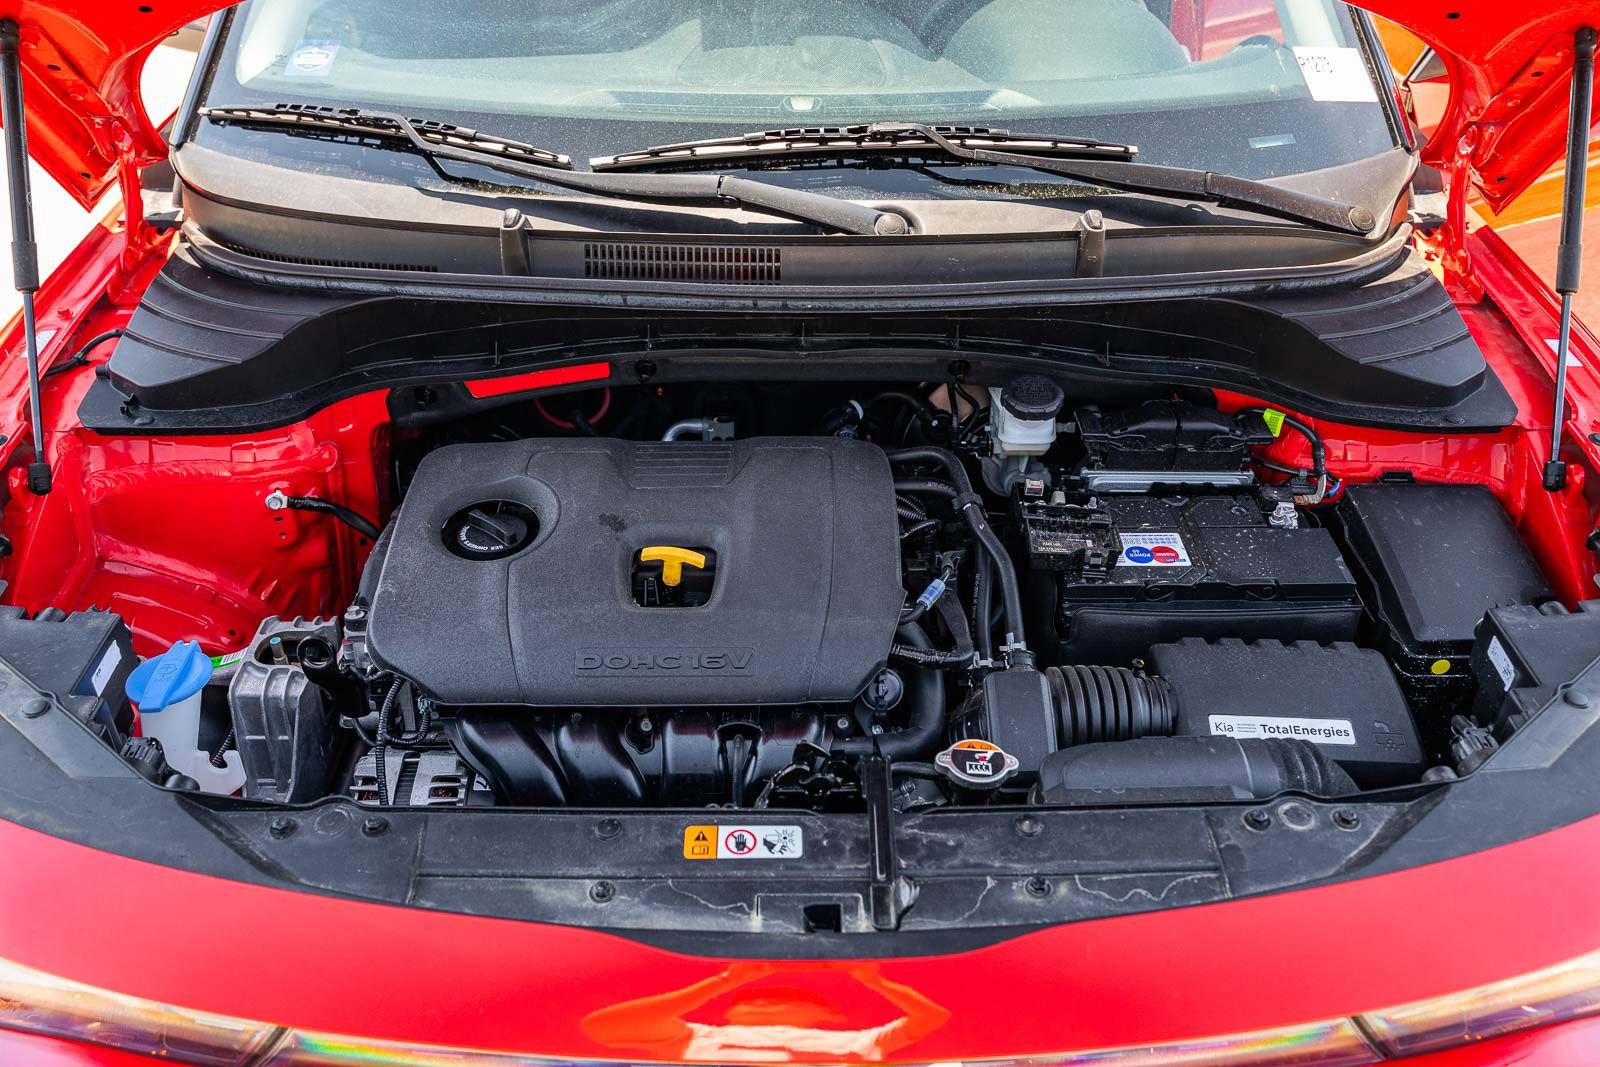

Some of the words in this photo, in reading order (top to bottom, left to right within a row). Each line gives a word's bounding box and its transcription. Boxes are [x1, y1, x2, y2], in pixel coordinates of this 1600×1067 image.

[576, 653, 682, 671] DOHC
[685, 652, 753, 671] 16V
[1214, 721, 1234, 733] Kia
[1259, 723, 1350, 738] TotalEnergies
